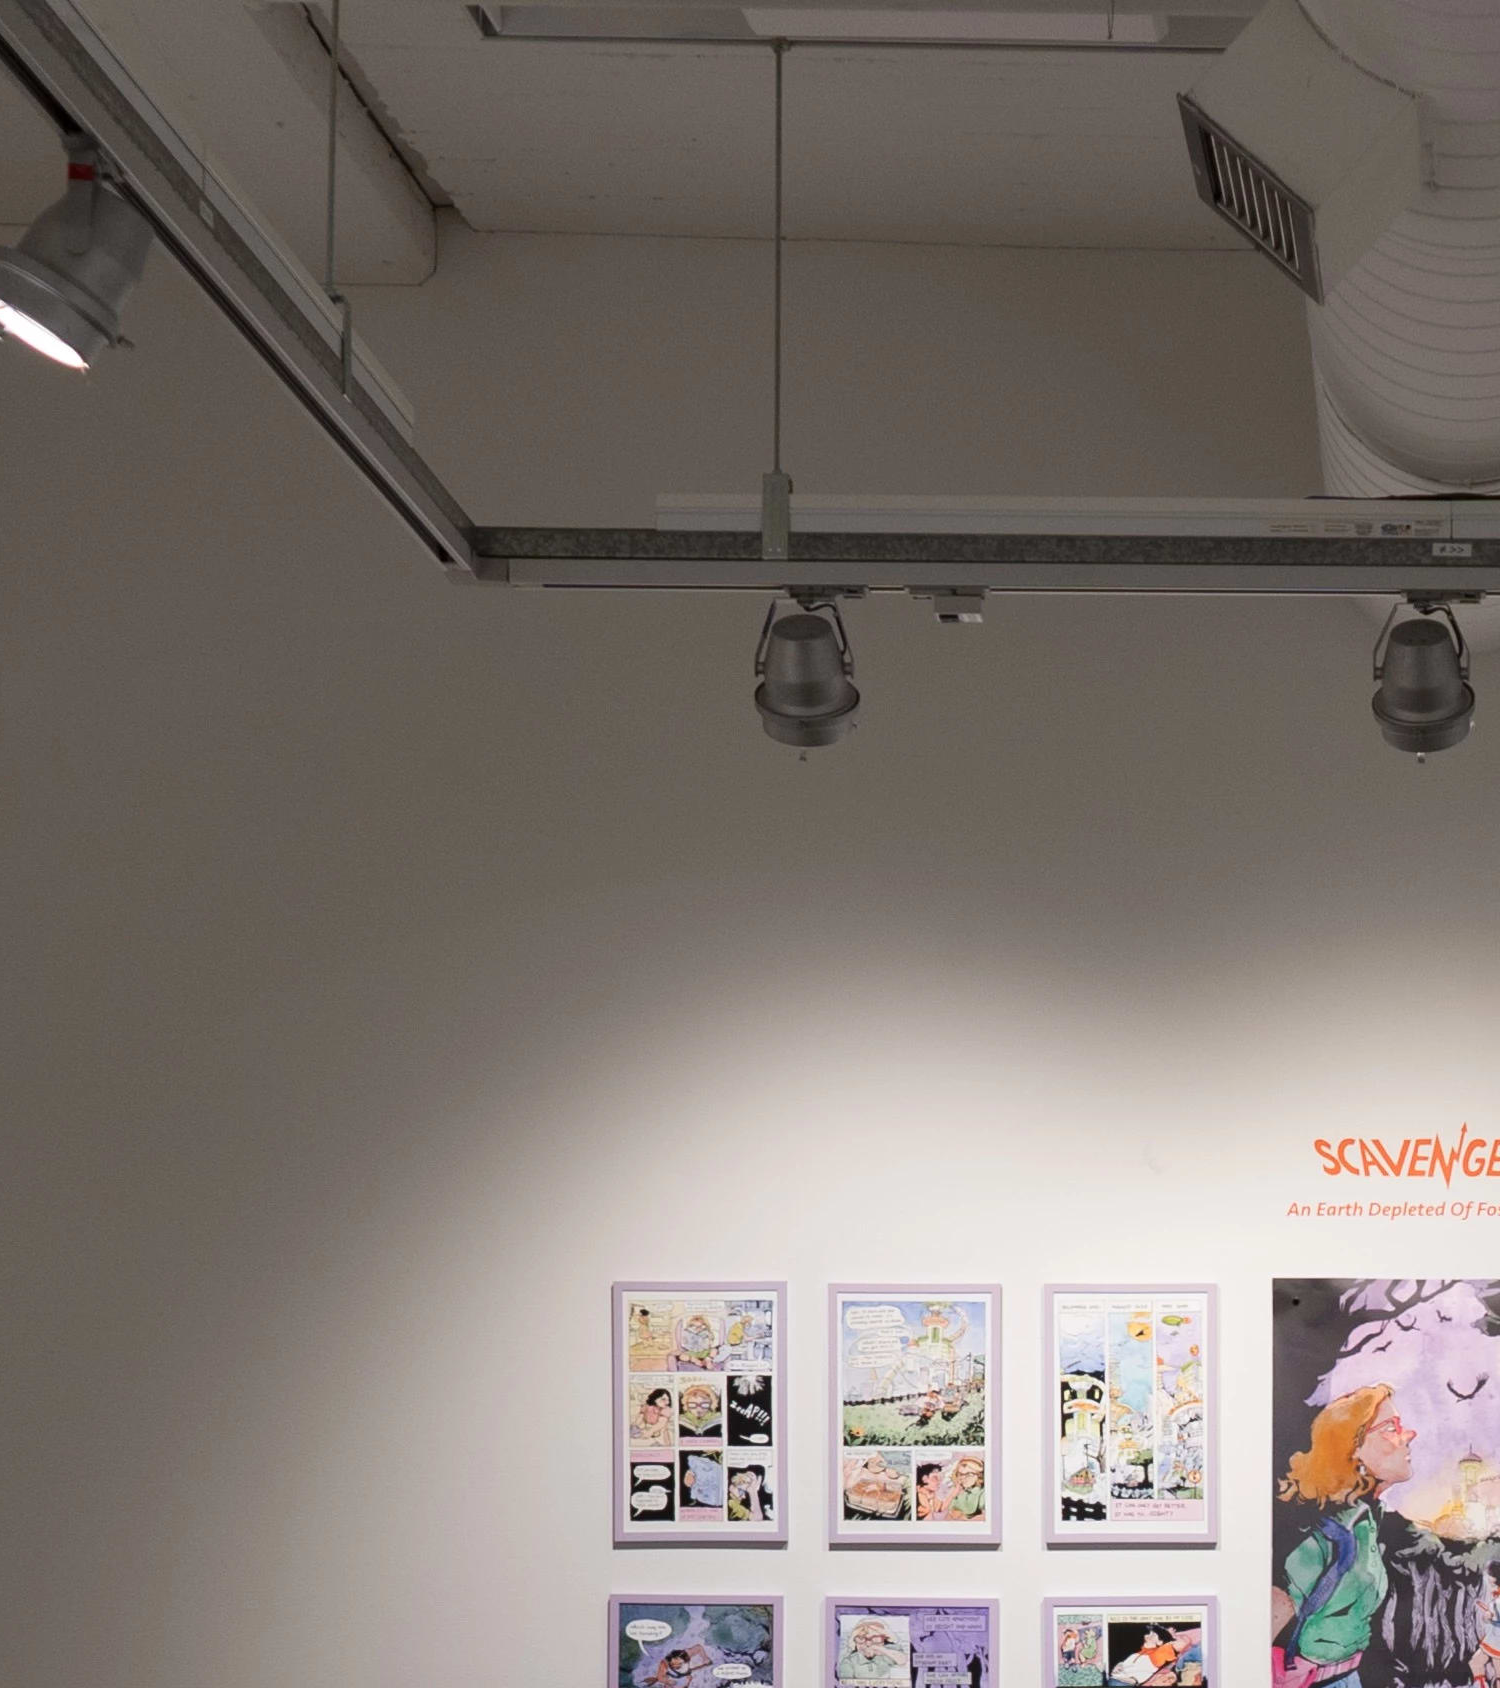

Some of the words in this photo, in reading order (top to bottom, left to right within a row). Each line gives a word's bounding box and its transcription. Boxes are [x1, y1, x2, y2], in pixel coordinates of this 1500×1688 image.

[1287, 1202, 1311, 1217] An
[1316, 1202, 1363, 1217] Earth
[1368, 1201, 1446, 1221] Depleted
[1450, 1201, 1472, 1221] Of
